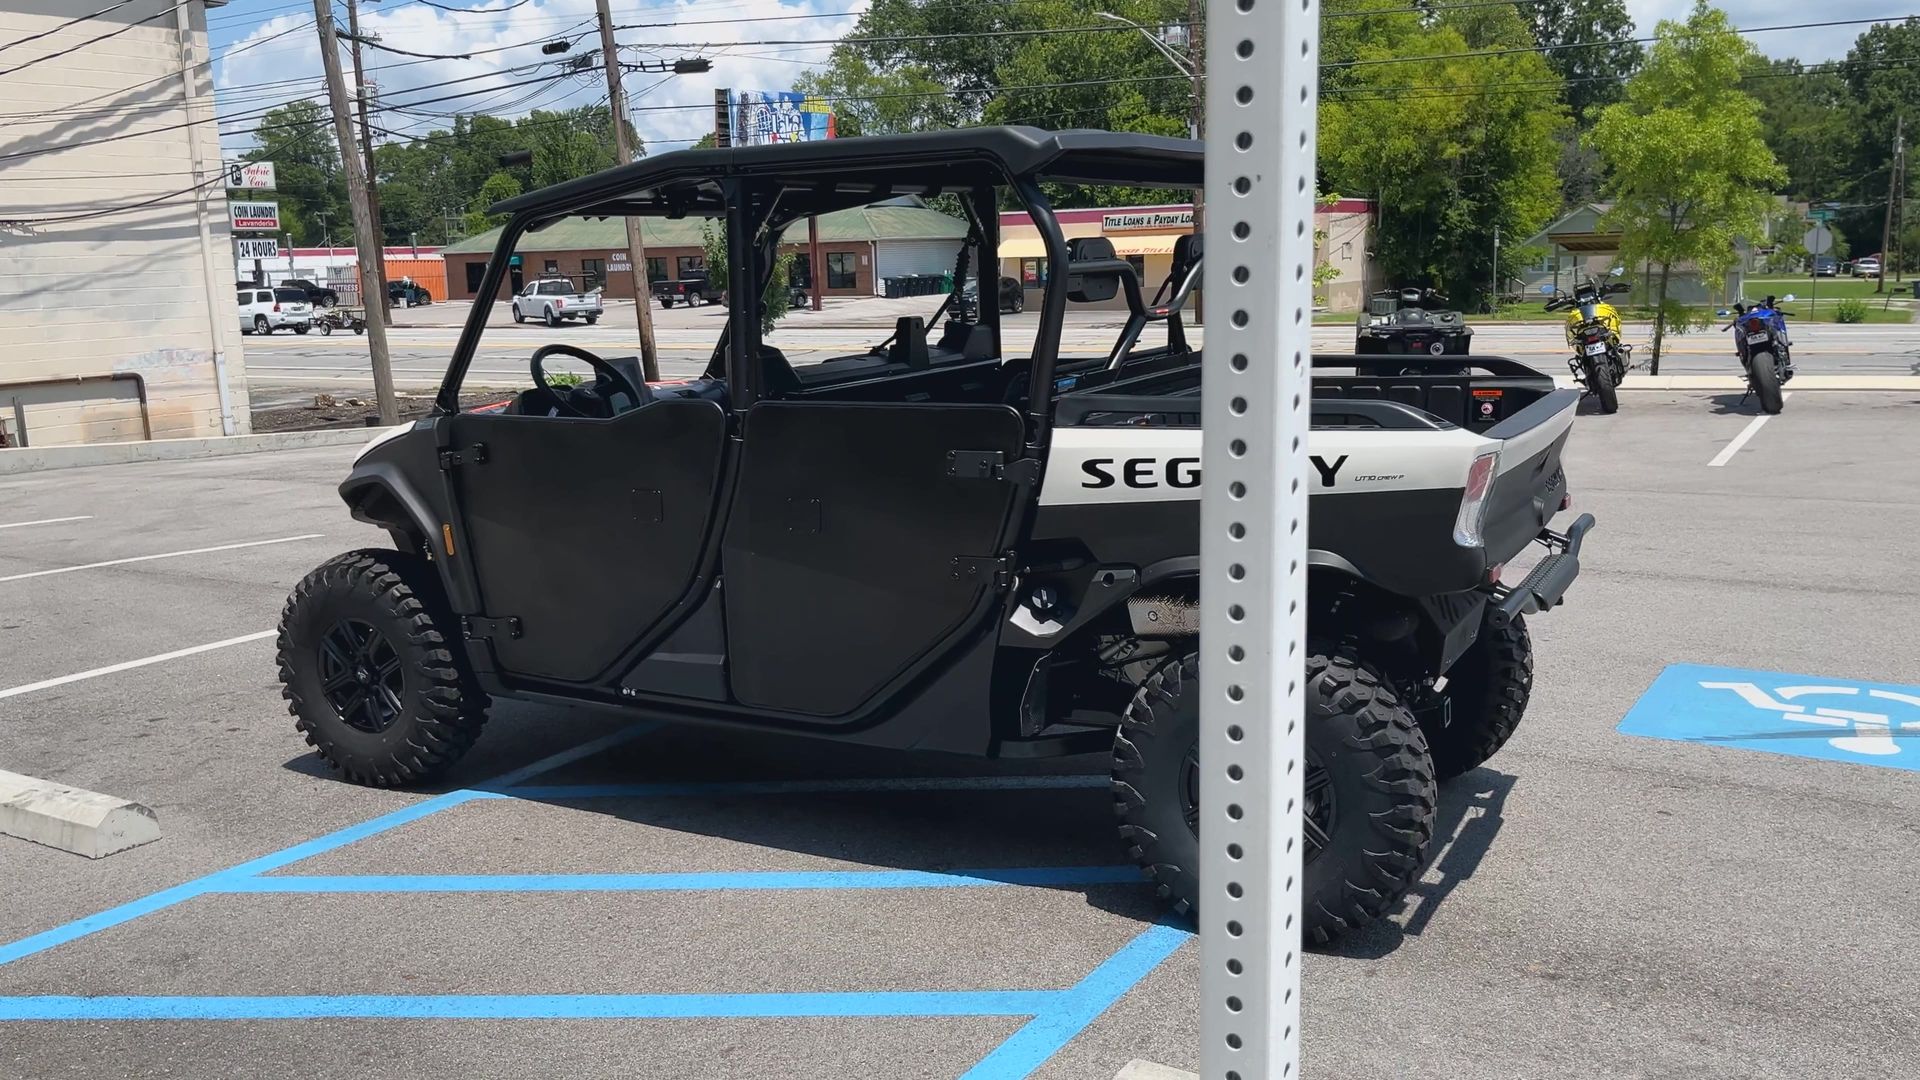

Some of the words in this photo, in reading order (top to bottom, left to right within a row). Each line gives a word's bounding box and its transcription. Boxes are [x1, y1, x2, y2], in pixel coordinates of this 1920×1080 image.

[249, 175, 268, 187] Care
[234, 206, 249, 218] COIN
[249, 206, 276, 218] LAUNDRY
[1147, 217, 1151, 225] &
[1154, 214, 1180, 225] PAYDAY
[240, 242, 250, 257] 24
[253, 241, 277, 257] HOURS
[612, 253, 627, 261] COIN
